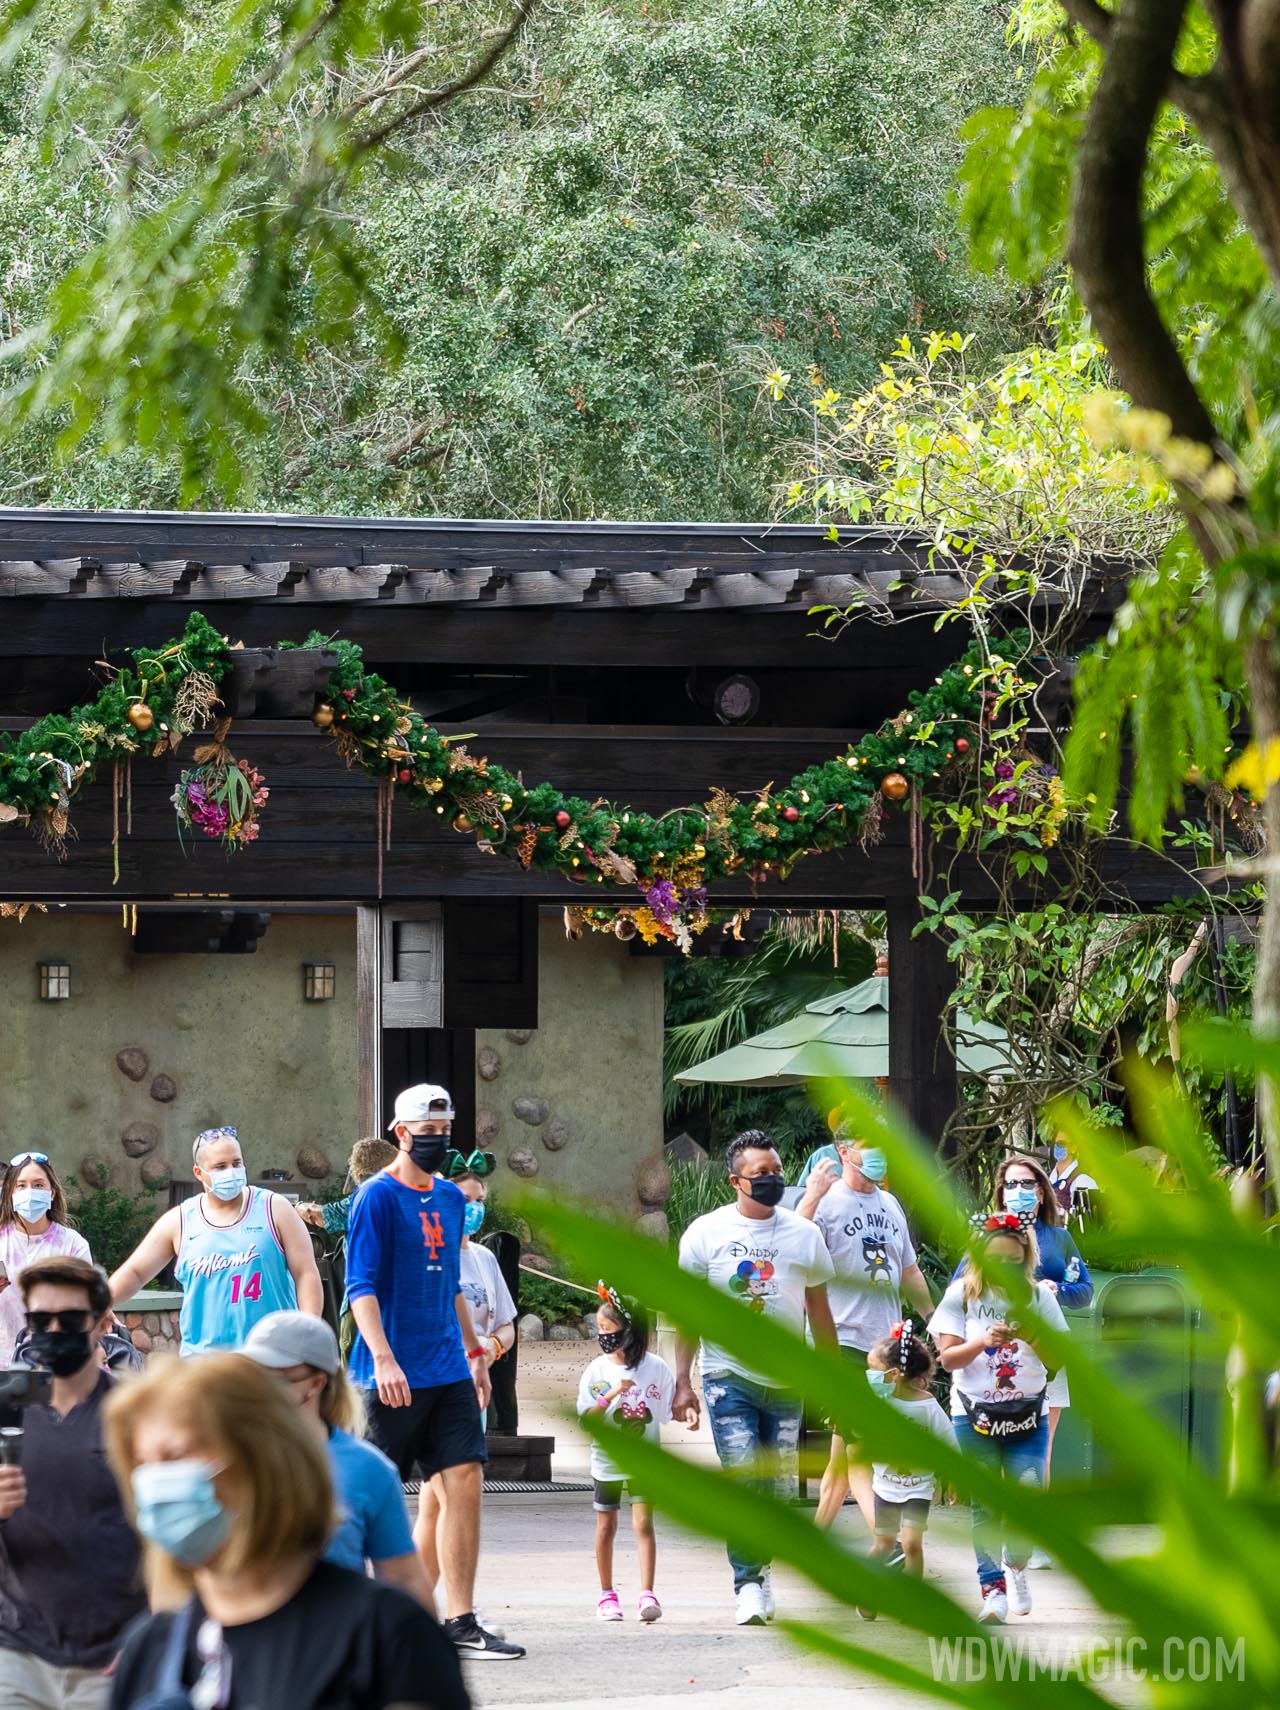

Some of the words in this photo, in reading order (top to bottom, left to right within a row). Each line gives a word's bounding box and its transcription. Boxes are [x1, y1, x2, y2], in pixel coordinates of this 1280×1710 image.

[419, 1211, 445, 1260] NY
[844, 1216, 864, 1237] GO
[867, 1213, 899, 1236] AWAY
[189, 1244, 261, 1280] Miami
[231, 1271, 263, 1305] 14
[983, 1390, 1024, 1404] 2020
